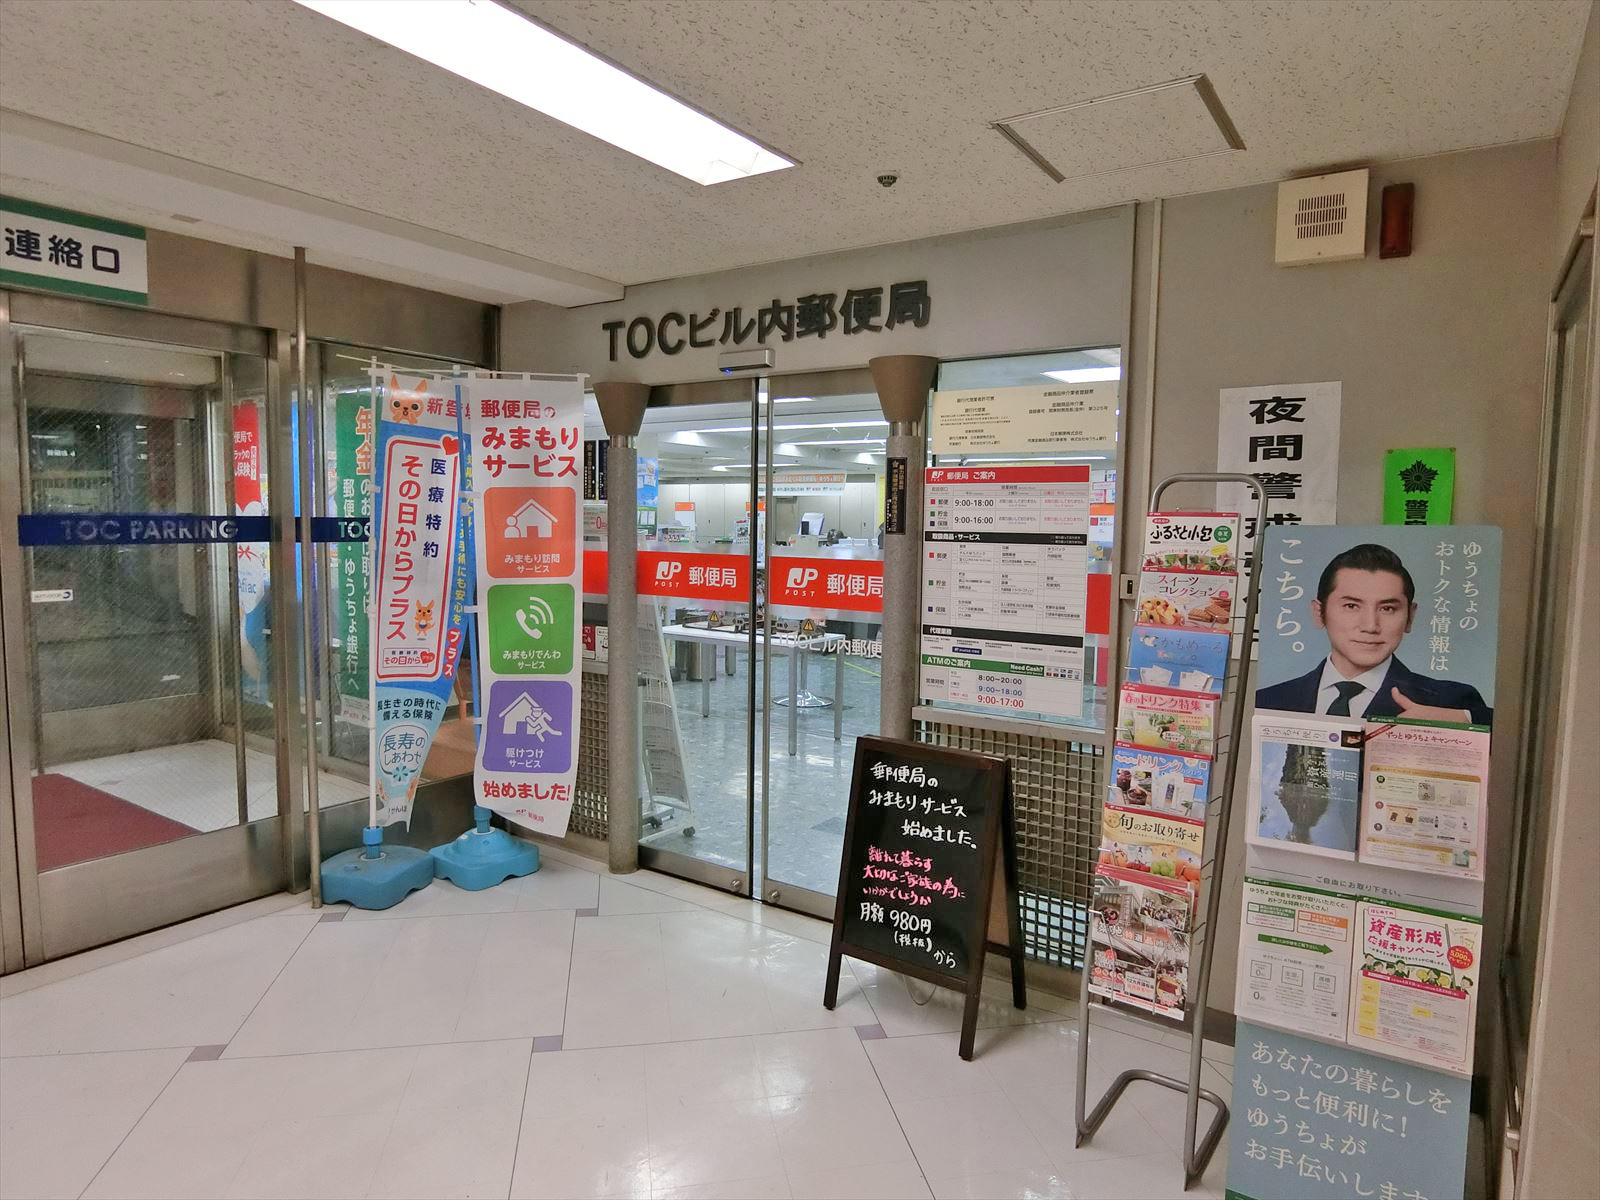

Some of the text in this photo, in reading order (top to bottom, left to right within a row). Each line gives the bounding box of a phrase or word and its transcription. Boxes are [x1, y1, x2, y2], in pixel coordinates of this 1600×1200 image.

[5, 228, 120, 274] 連絡口
[602, 280, 932, 361] TOCビル内郵便局
[481, 400, 556, 419] 郵便局の
[482, 426, 579, 450] みまもり
[483, 454, 578, 478] サービス
[424, 458, 447, 558] 医療特約
[954, 499, 994, 507] 9:00-18:00
[61, 520, 238, 541] TOC PARKING
[954, 516, 994, 524] 9:00-16:00
[1150, 525, 1213, 542] ふるさと小包
[386, 455, 423, 641] その日からプラス
[504, 554, 561, 564] みまもり訪問
[516, 565, 550, 574] サービス
[655, 561, 737, 588] JP 郵便局
[1158, 575, 1199, 587] スイーツ
[785, 589, 816, 597] POST
[786, 567, 884, 599] JP 郵便局
[1159, 586, 1217, 598] コレクション
[1459, 541, 1482, 631] ゆうちょの
[1276, 539, 1304, 653] こちら。
[1429, 541, 1455, 672] おトクな情報は
[502, 649, 561, 660] みまもりでんわ
[517, 661, 545, 670] サービス
[926, 656, 971, 668] ATMのご案内
[977, 695, 1024, 708] 9:00-17:00
[383, 732, 426, 753] 長寿の
[505, 747, 545, 759] 駆けつけ
[508, 759, 542, 769] サービス
[869, 761, 939, 788] 郵便局の
[482, 780, 572, 802] 始めました!
[901, 819, 977, 850] 始めました。
[1120, 813, 1200, 842] 旬のお取り寄せ
[867, 844, 934, 872] 離れて暮らす
[863, 864, 966, 899] 大切なご家族の為に
[863, 886, 932, 906] いかがでしょうか
[860, 902, 932, 935] 月額 980円
[1369, 918, 1443, 947] 資産形成
[1368, 935, 1445, 958] 応援キャンペーン
[933, 950, 957, 969] から
[1251, 1040, 1452, 1114] あなたの暮らしを
[1252, 1073, 1407, 1138] もっと便利に!
[1247, 1107, 1367, 1155] ゆうちょが
